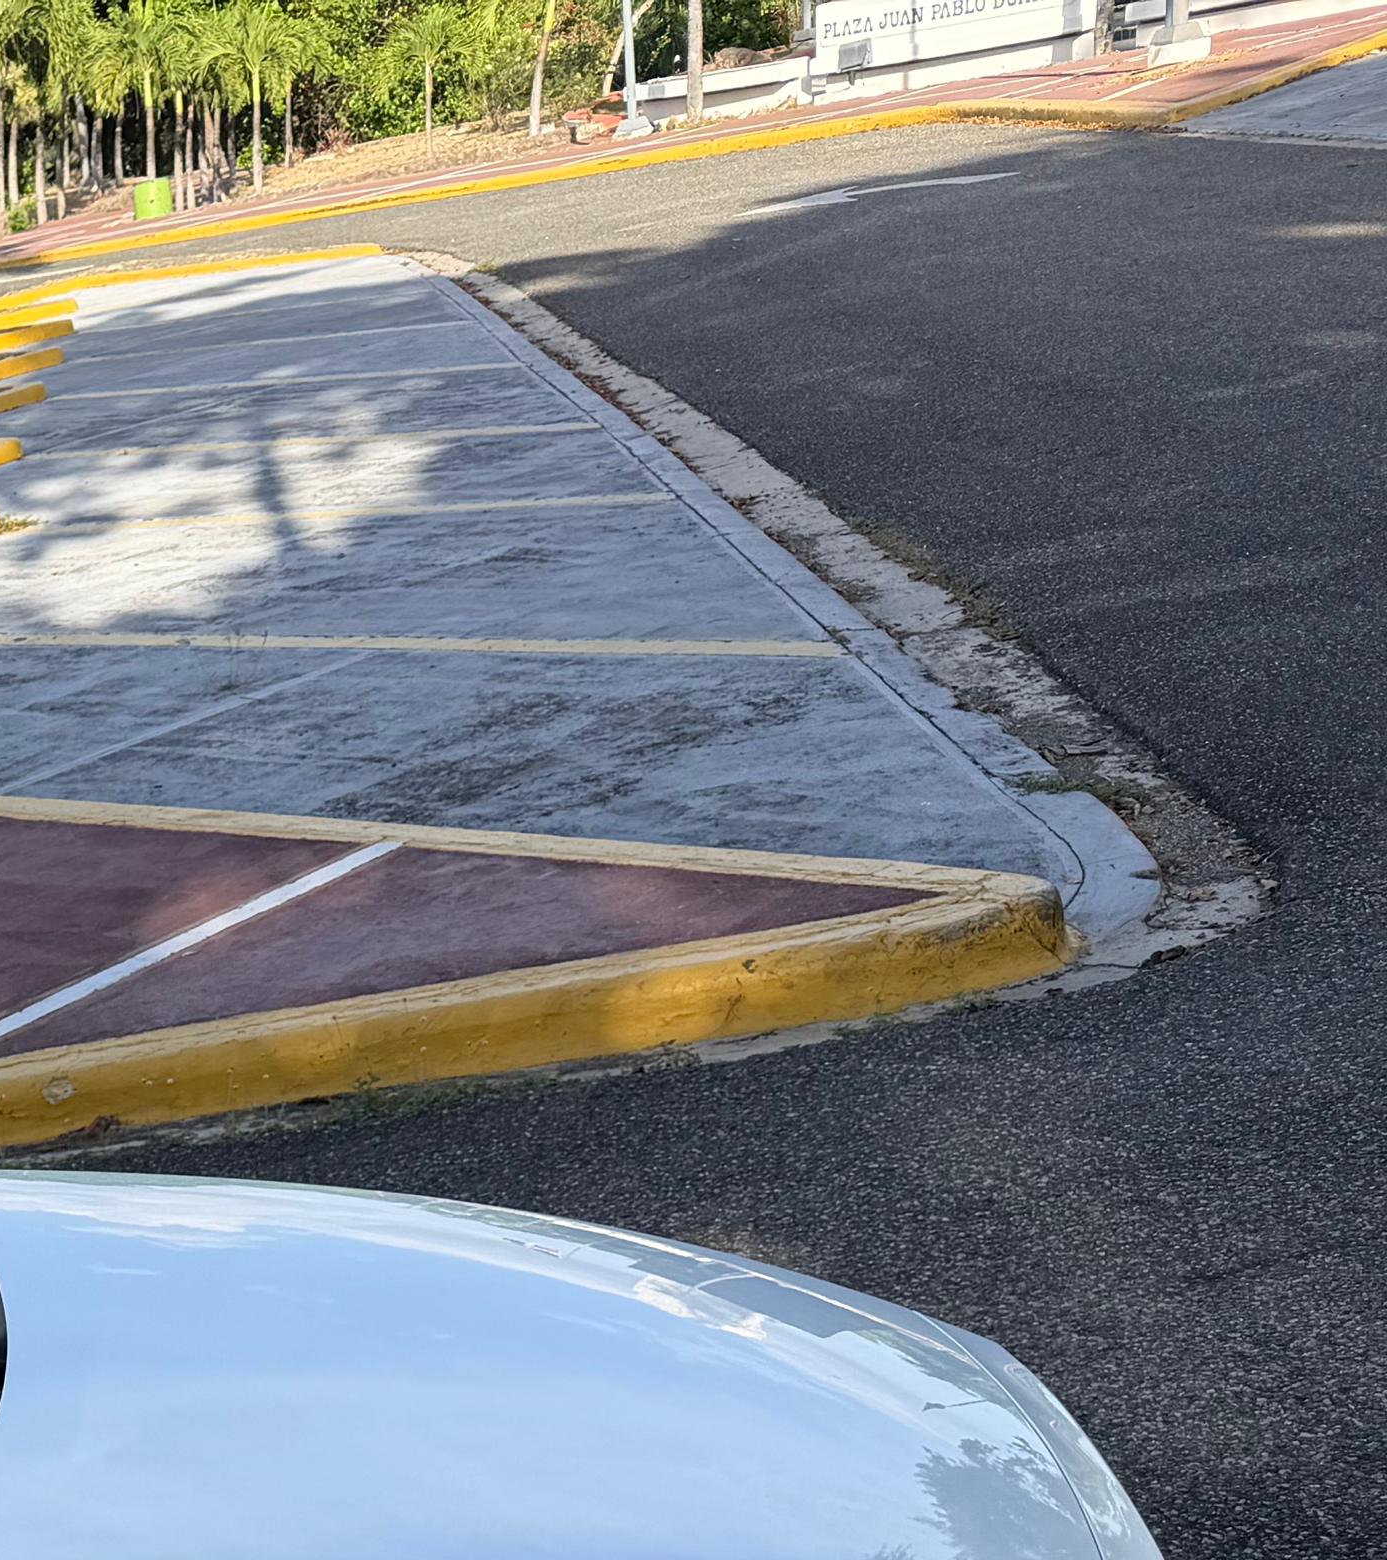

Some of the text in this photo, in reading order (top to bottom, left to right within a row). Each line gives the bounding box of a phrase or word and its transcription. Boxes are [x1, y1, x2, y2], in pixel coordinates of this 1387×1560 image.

[823, 0, 986, 39] PLAZA JUAN PABLO
